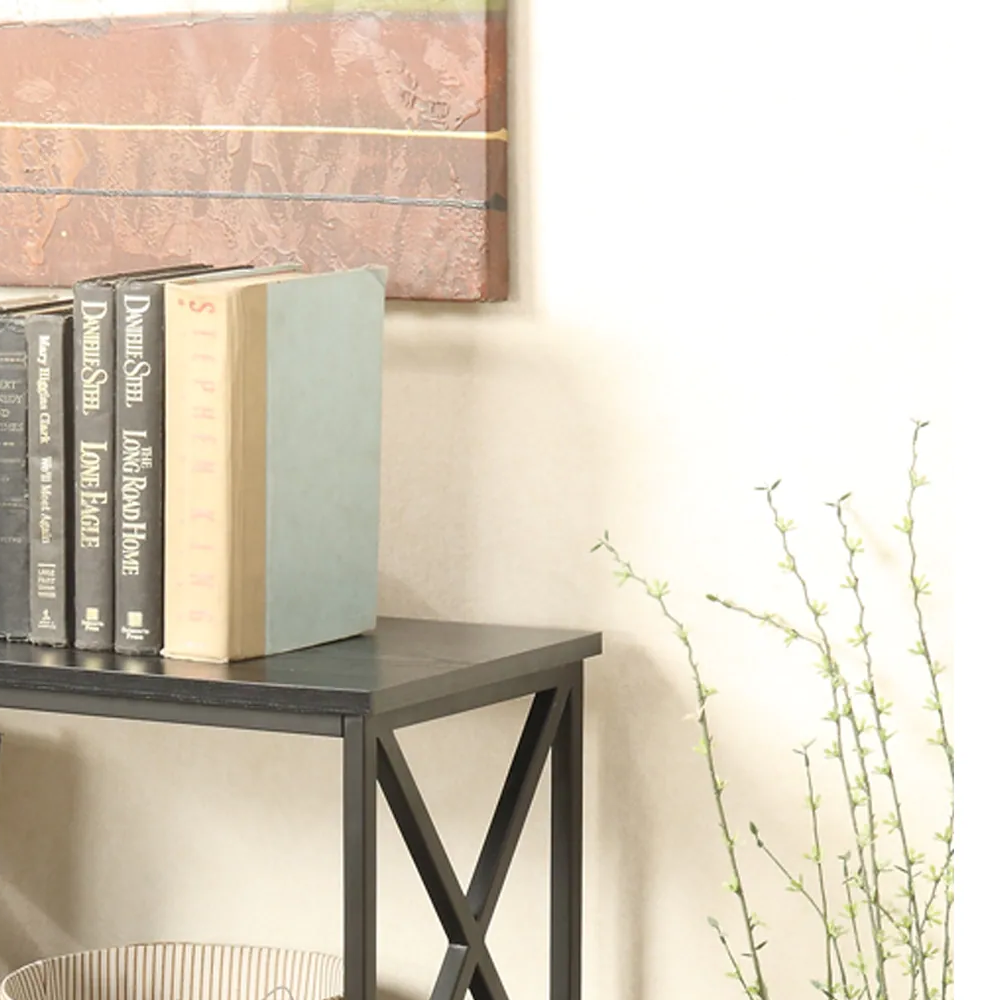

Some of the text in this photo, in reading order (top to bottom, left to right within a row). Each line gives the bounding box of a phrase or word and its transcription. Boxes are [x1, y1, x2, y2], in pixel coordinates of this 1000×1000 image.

[36, 334, 51, 444] Mary Higgins Clark
[80, 300, 108, 415] DANIELLE STEEL
[123, 294, 151, 408] DANIELLE STEEL
[80, 440, 108, 548] LONE EAGLE
[121, 429, 147, 576] LONG ROAD HOME
[141, 446, 152, 469] THE
[39, 512, 52, 544] Again
